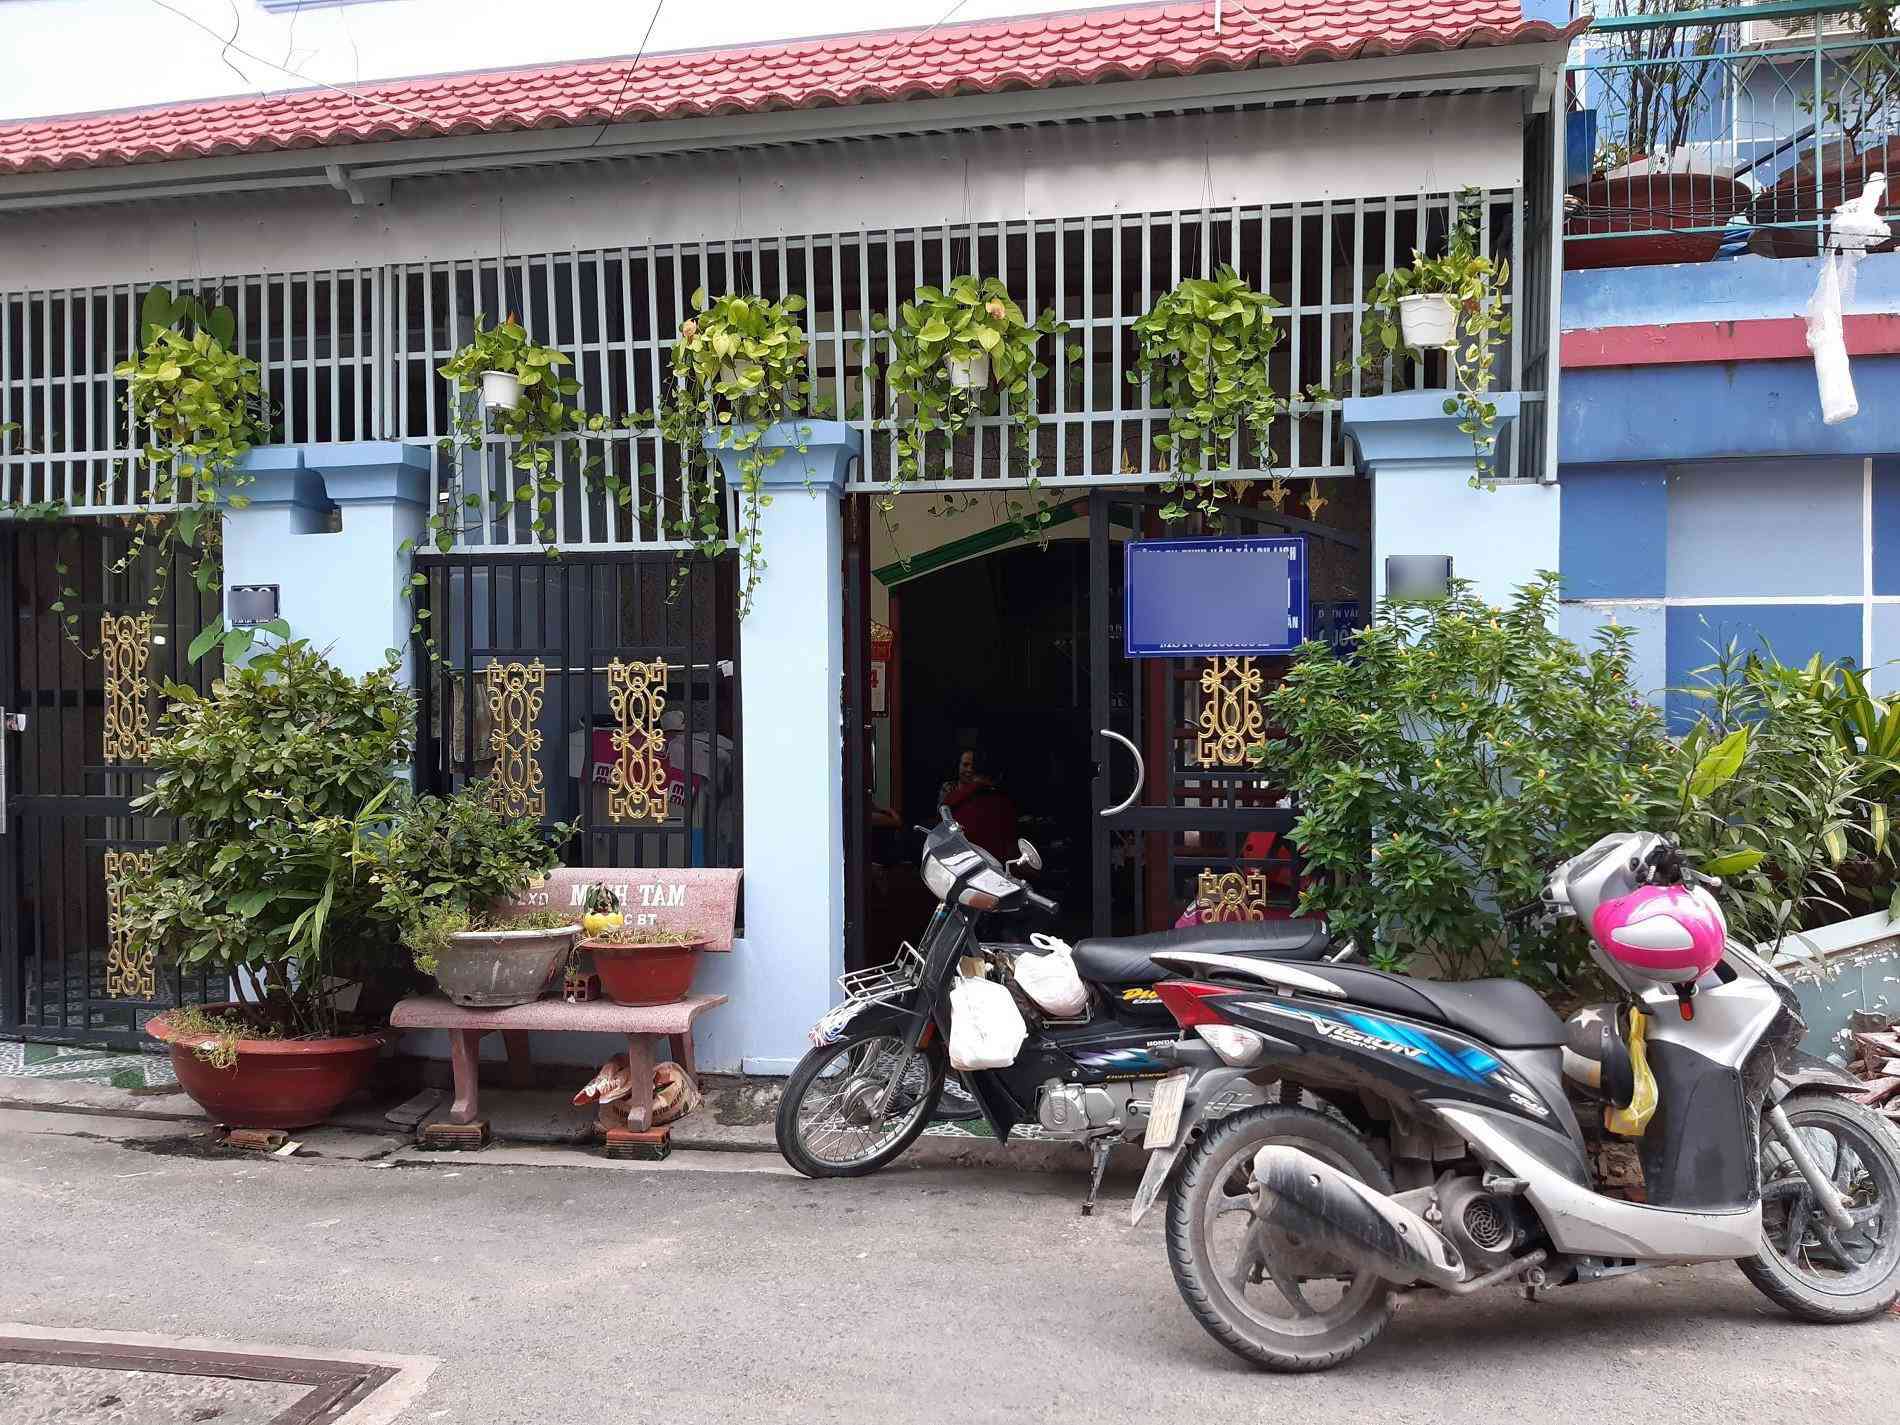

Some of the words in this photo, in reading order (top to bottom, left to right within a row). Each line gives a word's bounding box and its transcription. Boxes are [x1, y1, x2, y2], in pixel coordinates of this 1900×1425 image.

[569, 884, 629, 907] MH
[640, 879, 687, 907] TÂM
[638, 913, 657, 926] BT
[1146, 1039, 1175, 1047] HONDA
